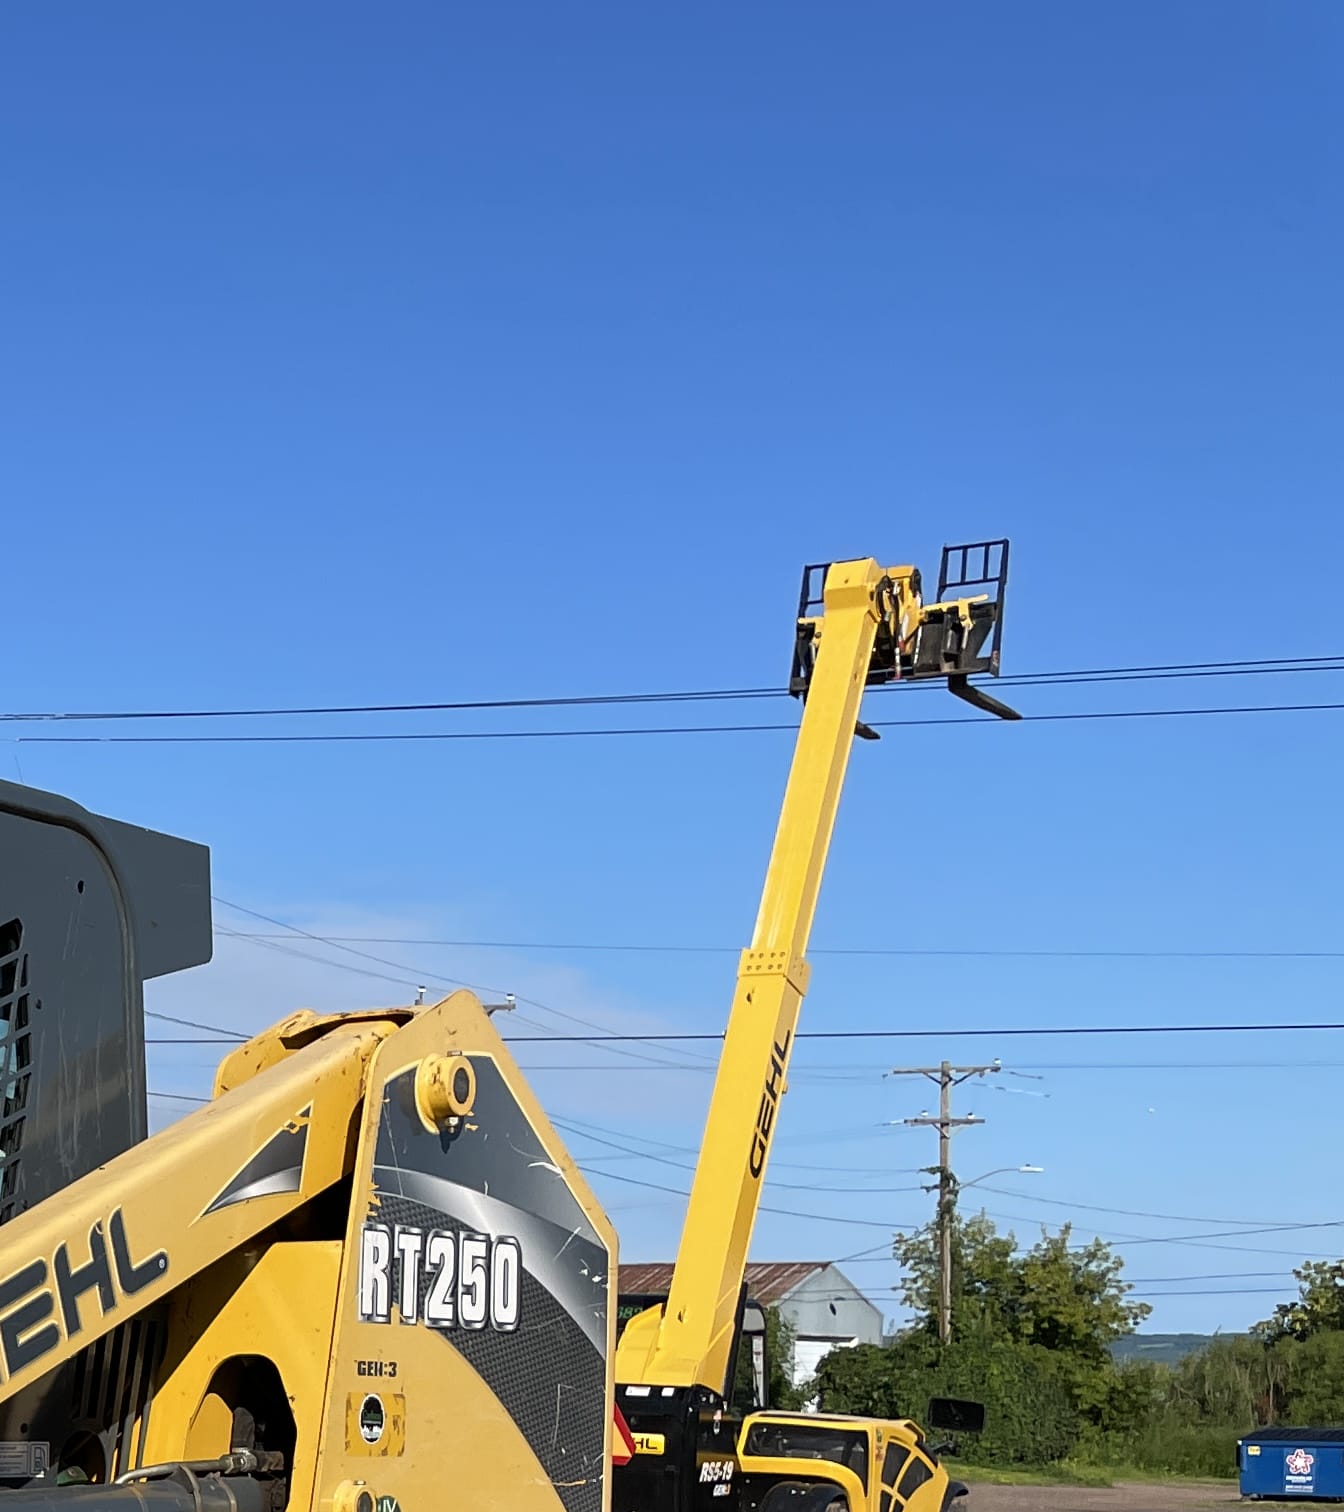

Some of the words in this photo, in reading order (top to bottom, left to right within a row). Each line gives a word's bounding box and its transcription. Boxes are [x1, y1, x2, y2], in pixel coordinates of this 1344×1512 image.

[749, 1029, 790, 1178] GEHL
[359, 1222, 523, 1333] RT250
[634, 1436, 658, 1450] HL
